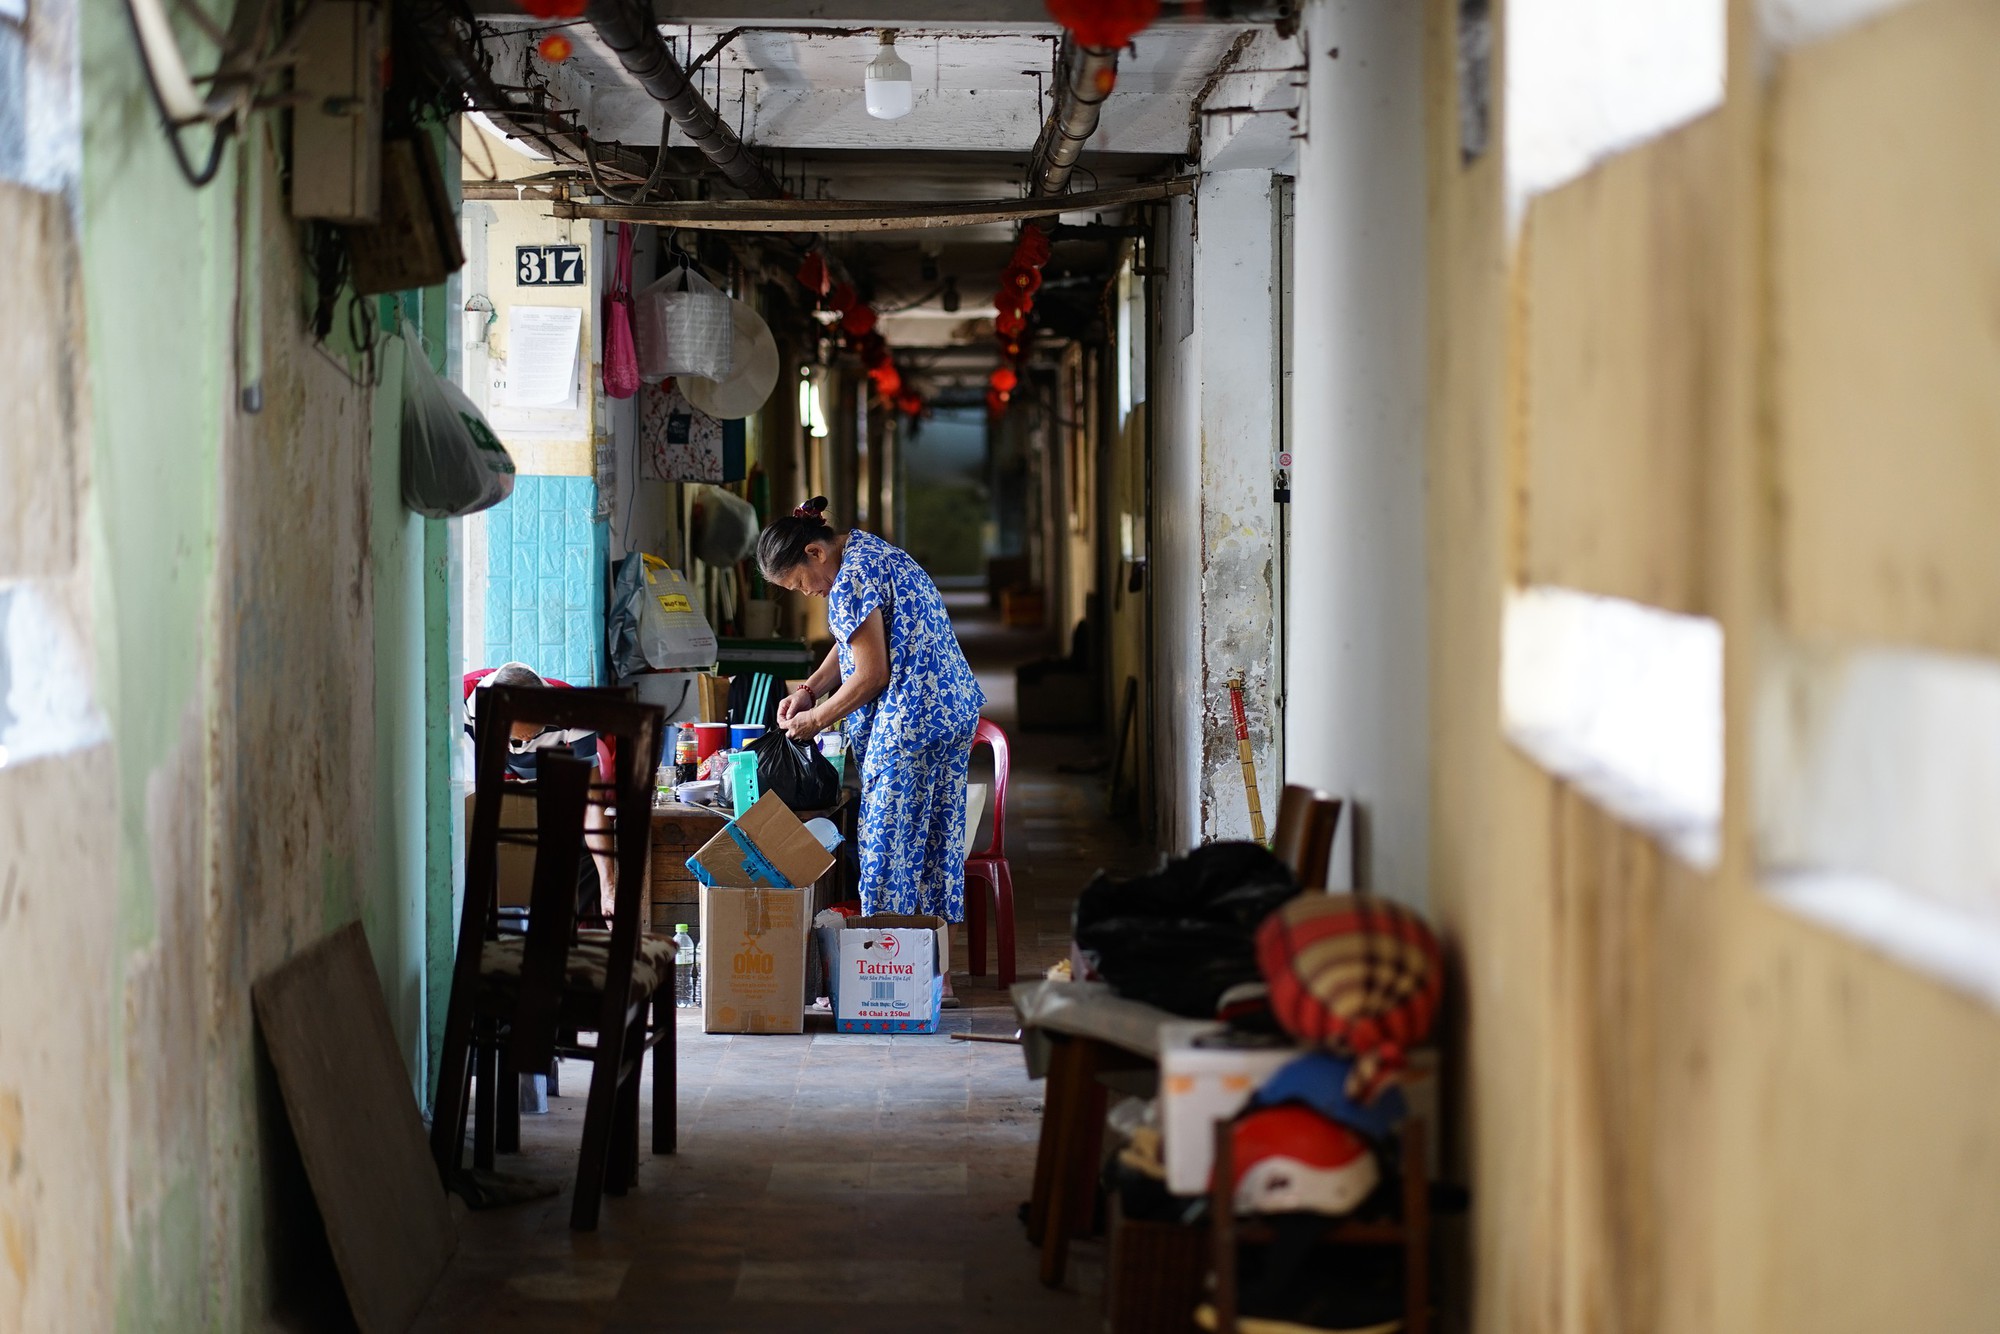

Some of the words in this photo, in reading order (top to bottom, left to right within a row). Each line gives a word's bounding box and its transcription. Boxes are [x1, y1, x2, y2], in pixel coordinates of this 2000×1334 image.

[520, 250, 580, 283] 317
[734, 953, 774, 974] OMO
[856, 960, 913, 974] Tatriwa
